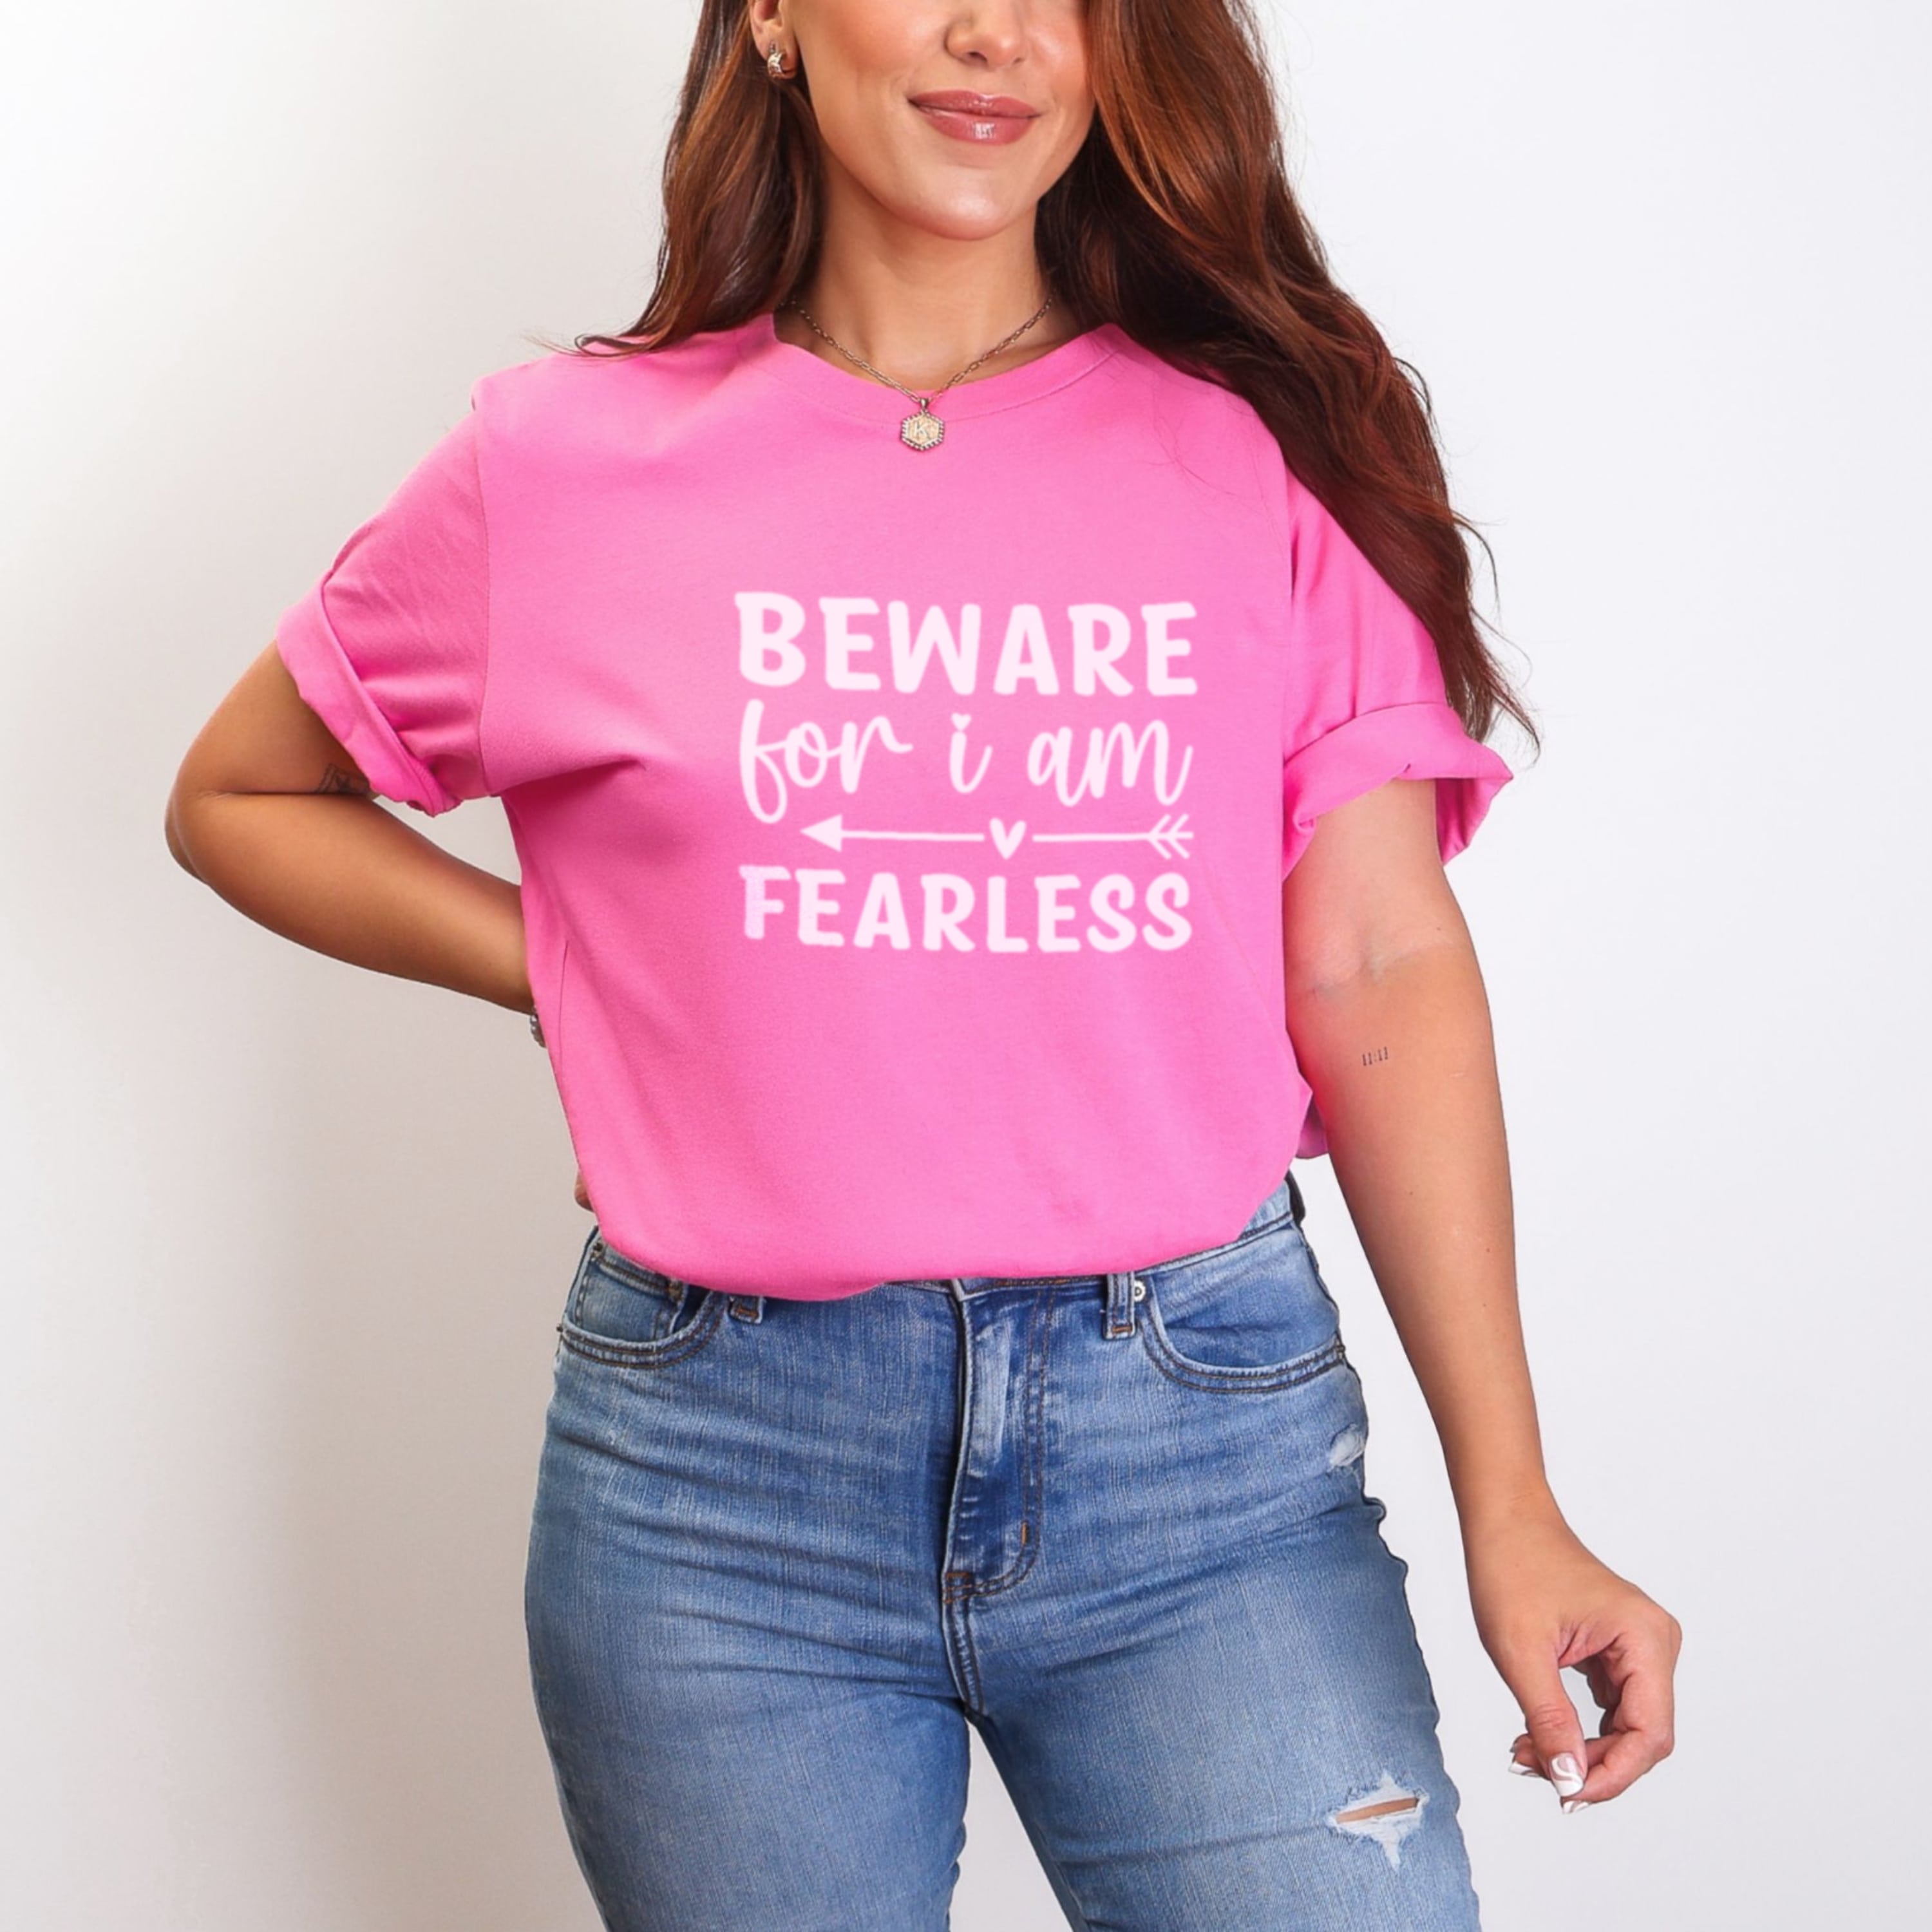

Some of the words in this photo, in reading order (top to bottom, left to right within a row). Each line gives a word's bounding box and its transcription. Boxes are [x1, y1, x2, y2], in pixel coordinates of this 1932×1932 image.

[734, 591, 1198, 696] BEWARE
[739, 698, 913, 824] for
[949, 712, 993, 794] i
[1027, 719, 1193, 807] am
[739, 865, 1192, 953] FEARLESS
